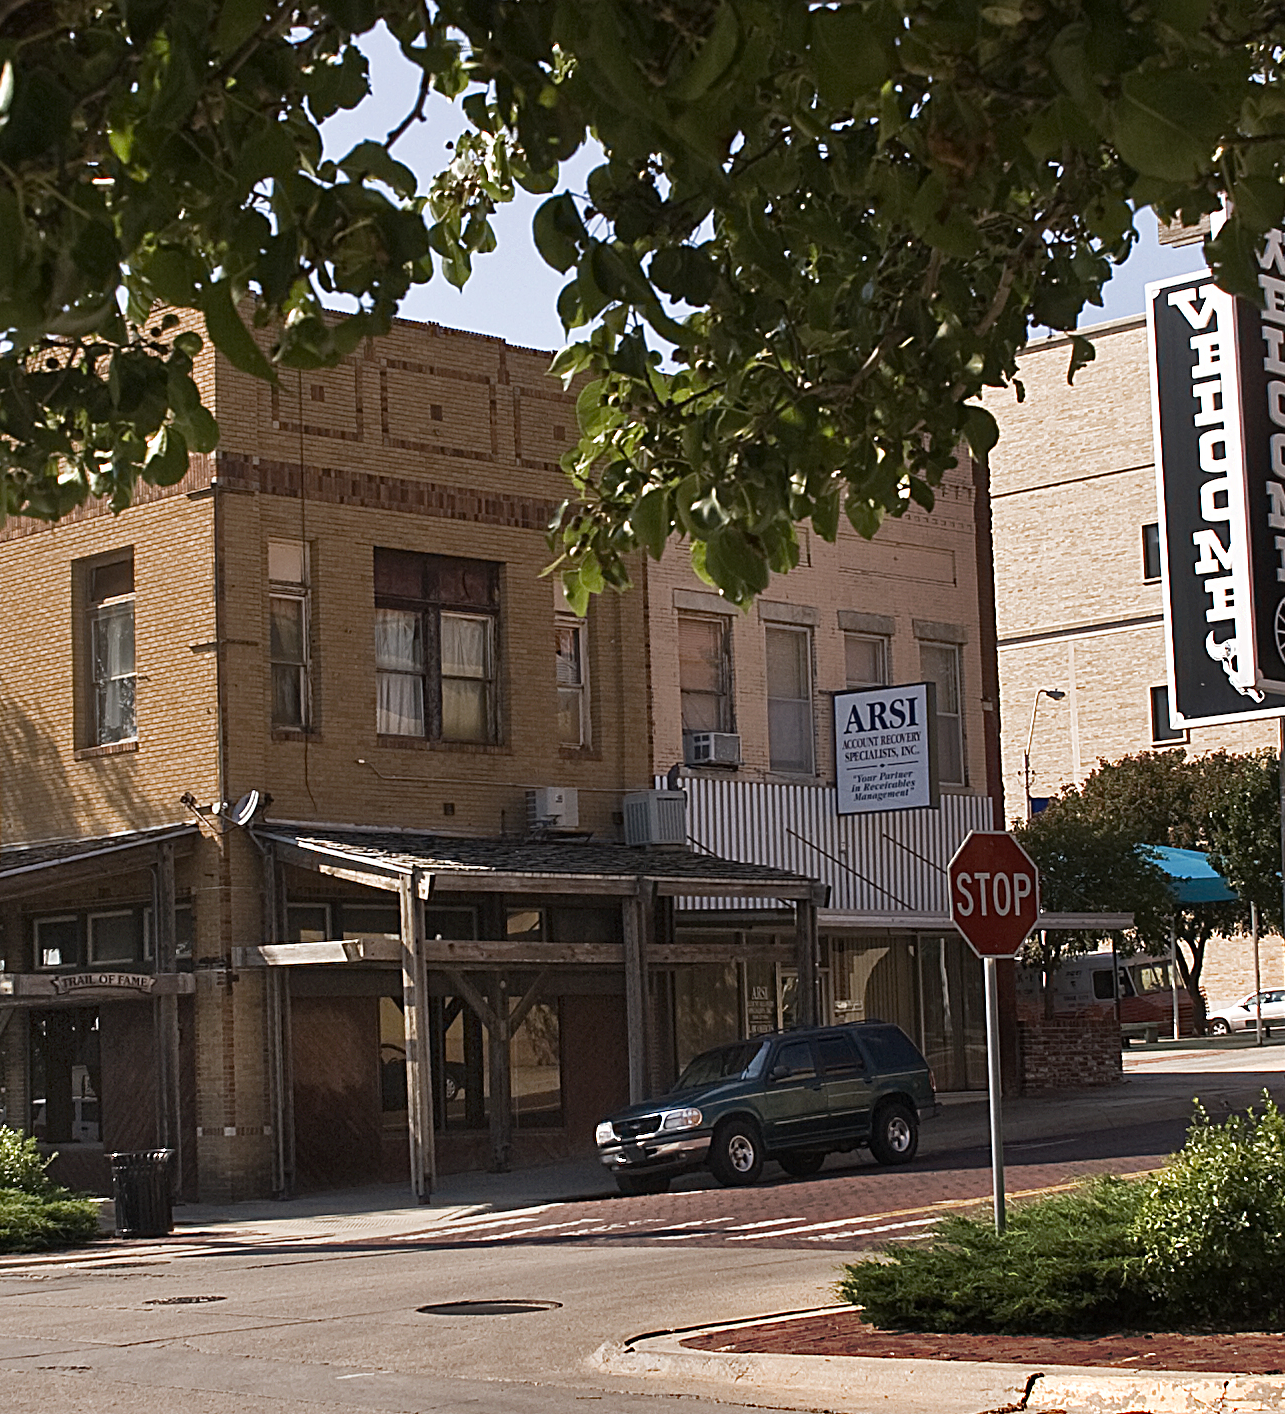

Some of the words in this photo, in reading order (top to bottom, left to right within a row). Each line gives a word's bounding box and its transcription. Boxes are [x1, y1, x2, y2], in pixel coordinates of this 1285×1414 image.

[843, 697, 919, 734] ARSI
[842, 736, 879, 750] ACCOUNT
[881, 731, 921, 745] RECOVERY
[845, 747, 899, 763] SPECIALISTS,
[901, 744, 920, 757] INC.
[879, 771, 913, 781] Partner
[851, 784, 861, 793] in
[863, 779, 916, 792] Receivables
[956, 871, 1032, 917] STOP
[63, 975, 94, 988] TRAIL
[98, 973, 116, 985] OF
[117, 975, 148, 987] FAME
